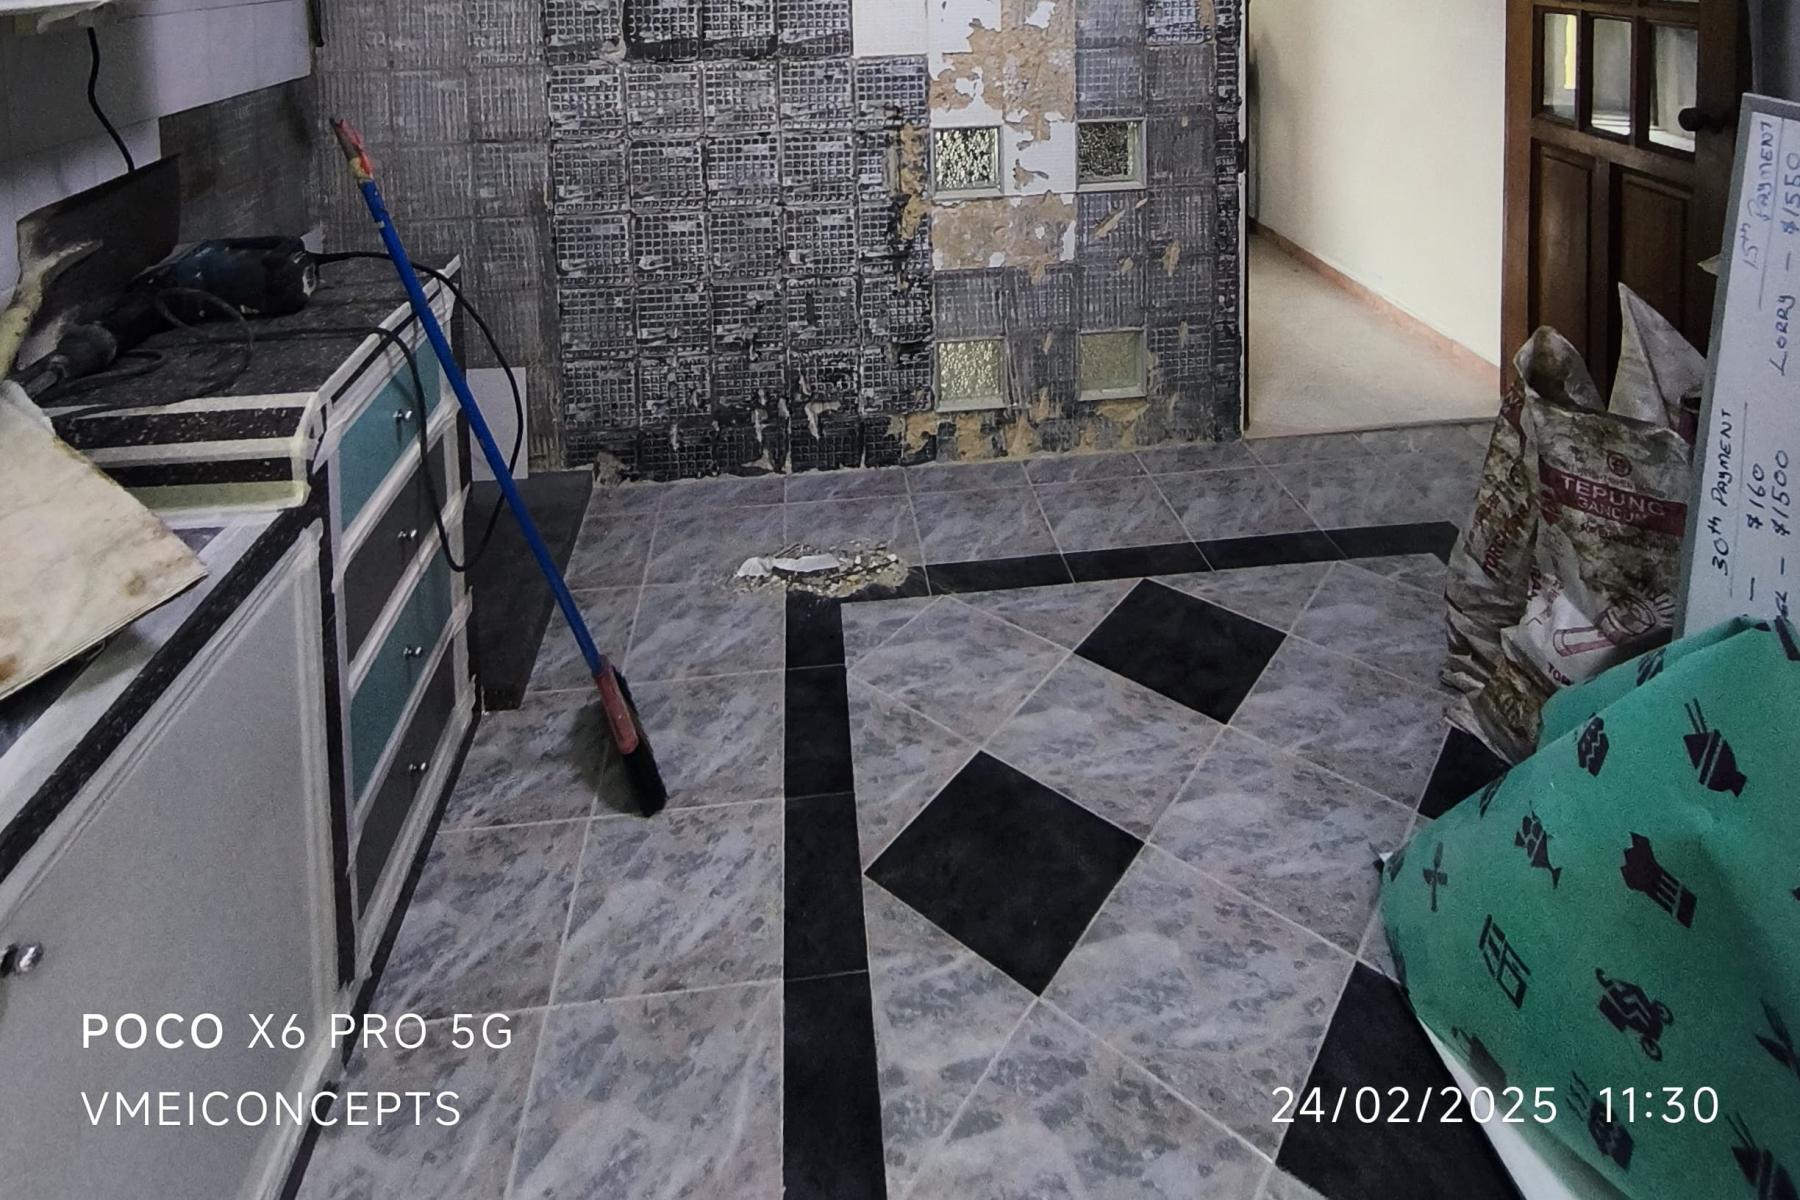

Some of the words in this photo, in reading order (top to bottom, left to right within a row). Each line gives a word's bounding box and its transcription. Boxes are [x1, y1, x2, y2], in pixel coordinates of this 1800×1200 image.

[1769, 294, 1796, 376] LORRY
[1561, 474, 1665, 516] TEPUNG
[1711, 408, 1733, 507] PAYMENT
[1747, 463, 1766, 529] $160
[1770, 450, 1791, 536] $1500
